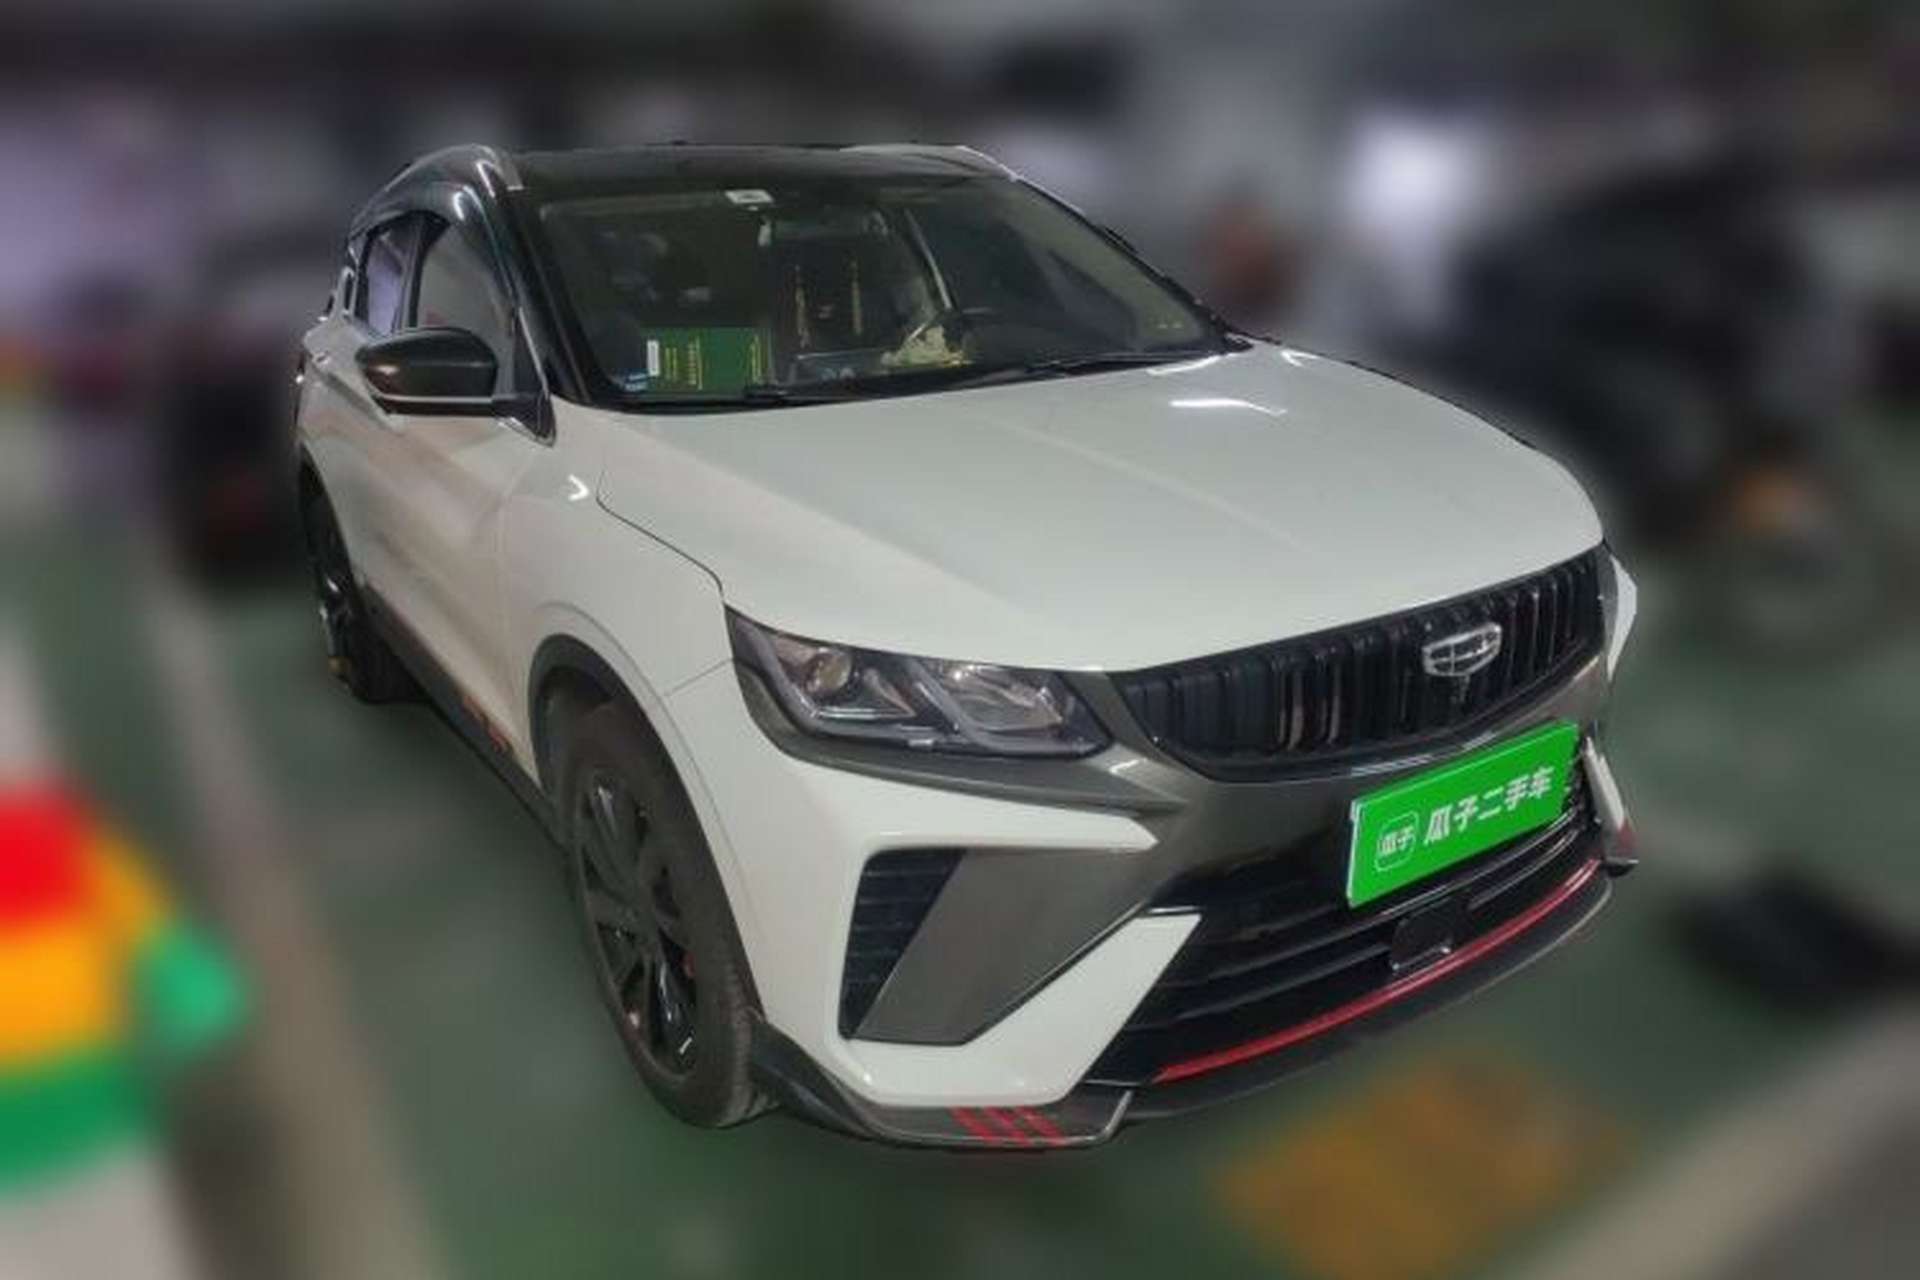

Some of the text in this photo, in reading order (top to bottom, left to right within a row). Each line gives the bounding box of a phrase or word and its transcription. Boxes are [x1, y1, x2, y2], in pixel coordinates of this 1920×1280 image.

[1424, 766, 1554, 845] 瓜子二手车
[1376, 826, 1415, 857] 瓜子
